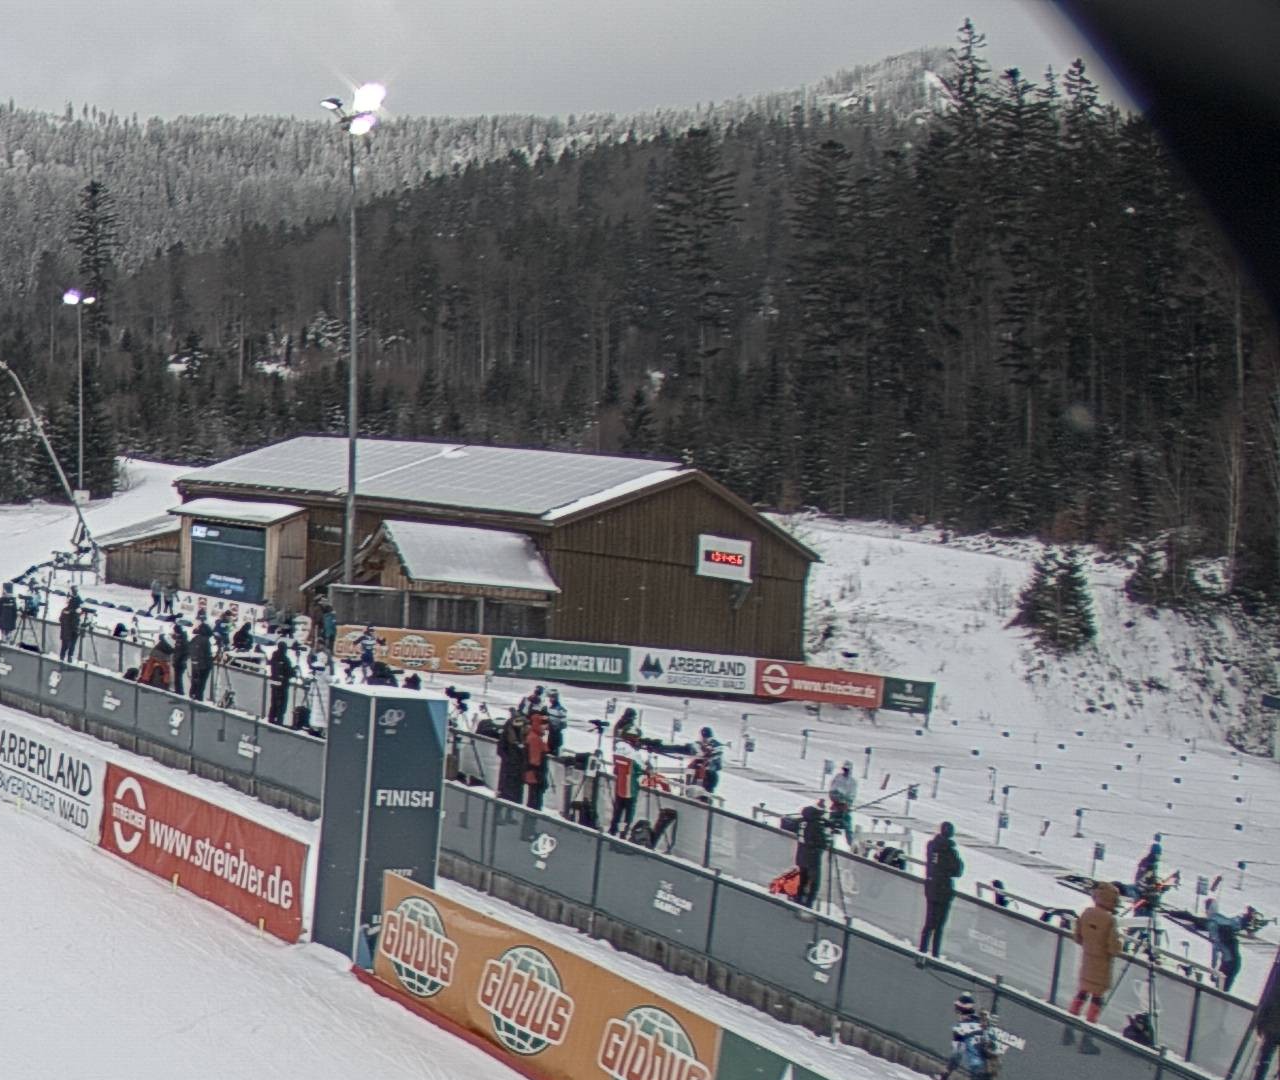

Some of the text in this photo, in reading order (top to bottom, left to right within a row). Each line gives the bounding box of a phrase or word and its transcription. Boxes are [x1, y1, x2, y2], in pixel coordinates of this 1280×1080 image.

[531, 652, 622, 674] BAYERISCHER WALD
[668, 655, 746, 677] ARBERLAND
[375, 789, 435, 808] FINISH
[58, 797, 89, 829] WALD
[149, 818, 294, 909] www.streicher.de
